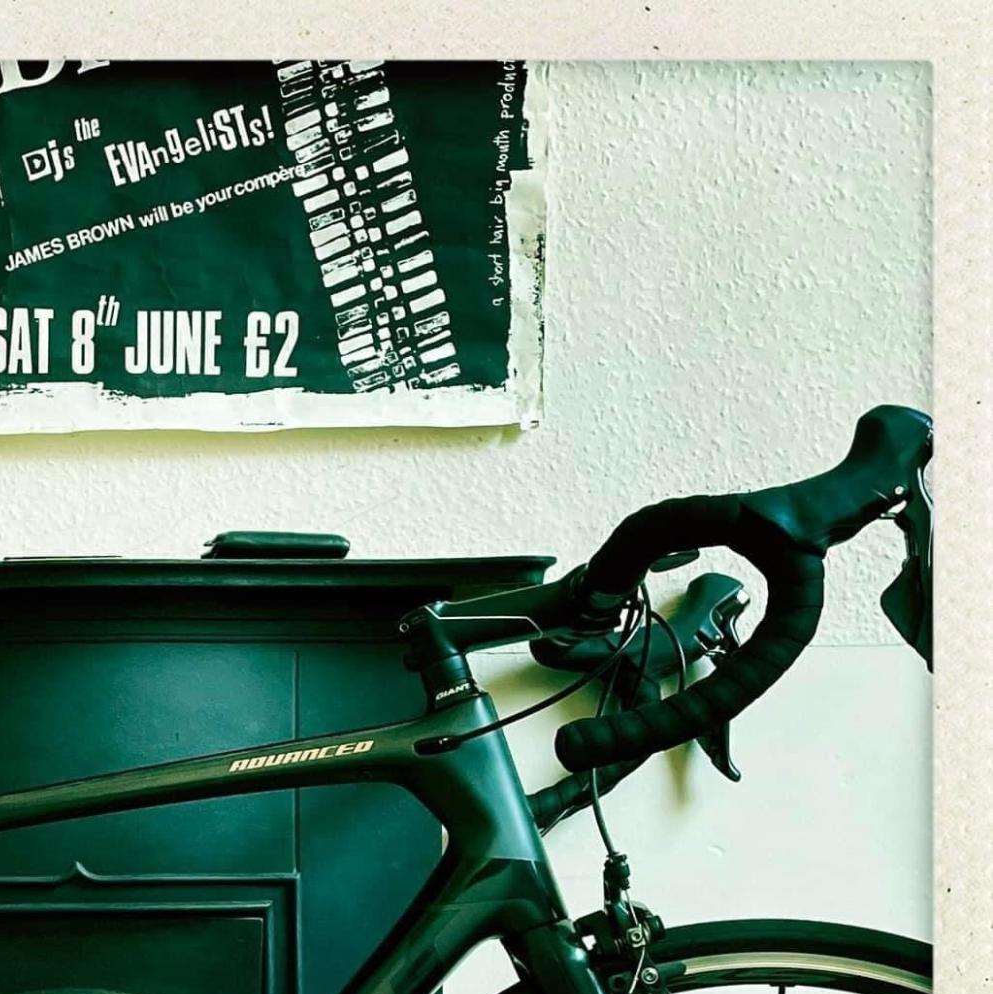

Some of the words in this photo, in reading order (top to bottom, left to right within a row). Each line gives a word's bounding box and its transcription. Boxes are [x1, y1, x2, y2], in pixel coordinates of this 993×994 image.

[74, 117, 101, 142] the
[492, 129, 510, 172] mouth
[489, 179, 509, 205] big
[5, 237, 66, 273] JAMES
[66, 214, 136, 251] BROWN
[138, 205, 169, 228] will
[171, 201, 195, 219] be
[195, 186, 233, 213] your
[488, 216, 504, 245] hair
[488, 253, 504, 287] short
[124, 308, 223, 377] JUNE
[435, 683, 471, 700] GIANT
[229, 740, 375, 772] ADVANCED
